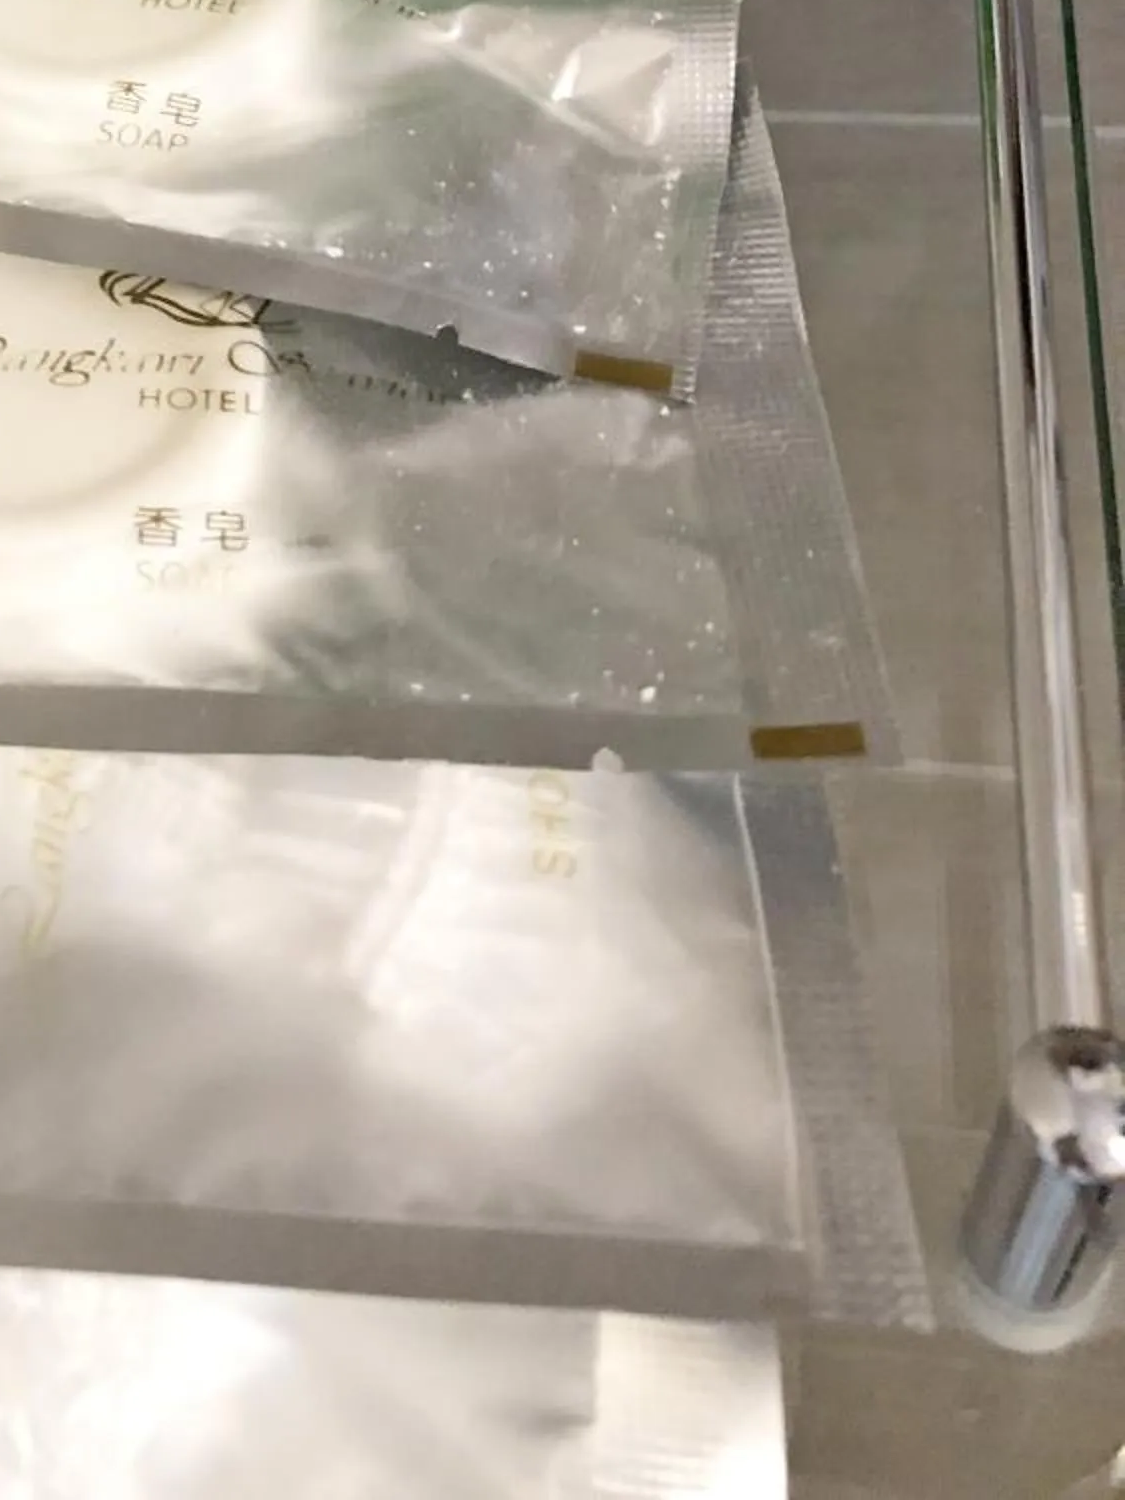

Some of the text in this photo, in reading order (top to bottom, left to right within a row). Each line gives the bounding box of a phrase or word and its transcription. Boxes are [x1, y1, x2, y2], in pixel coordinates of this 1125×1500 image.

[106, 79, 202, 127] 香皂
[96, 119, 190, 152] SOAP
[138, 387, 263, 416] HOTEL
[133, 505, 252, 552] 香皂
[527, 768, 579, 880] SHO
